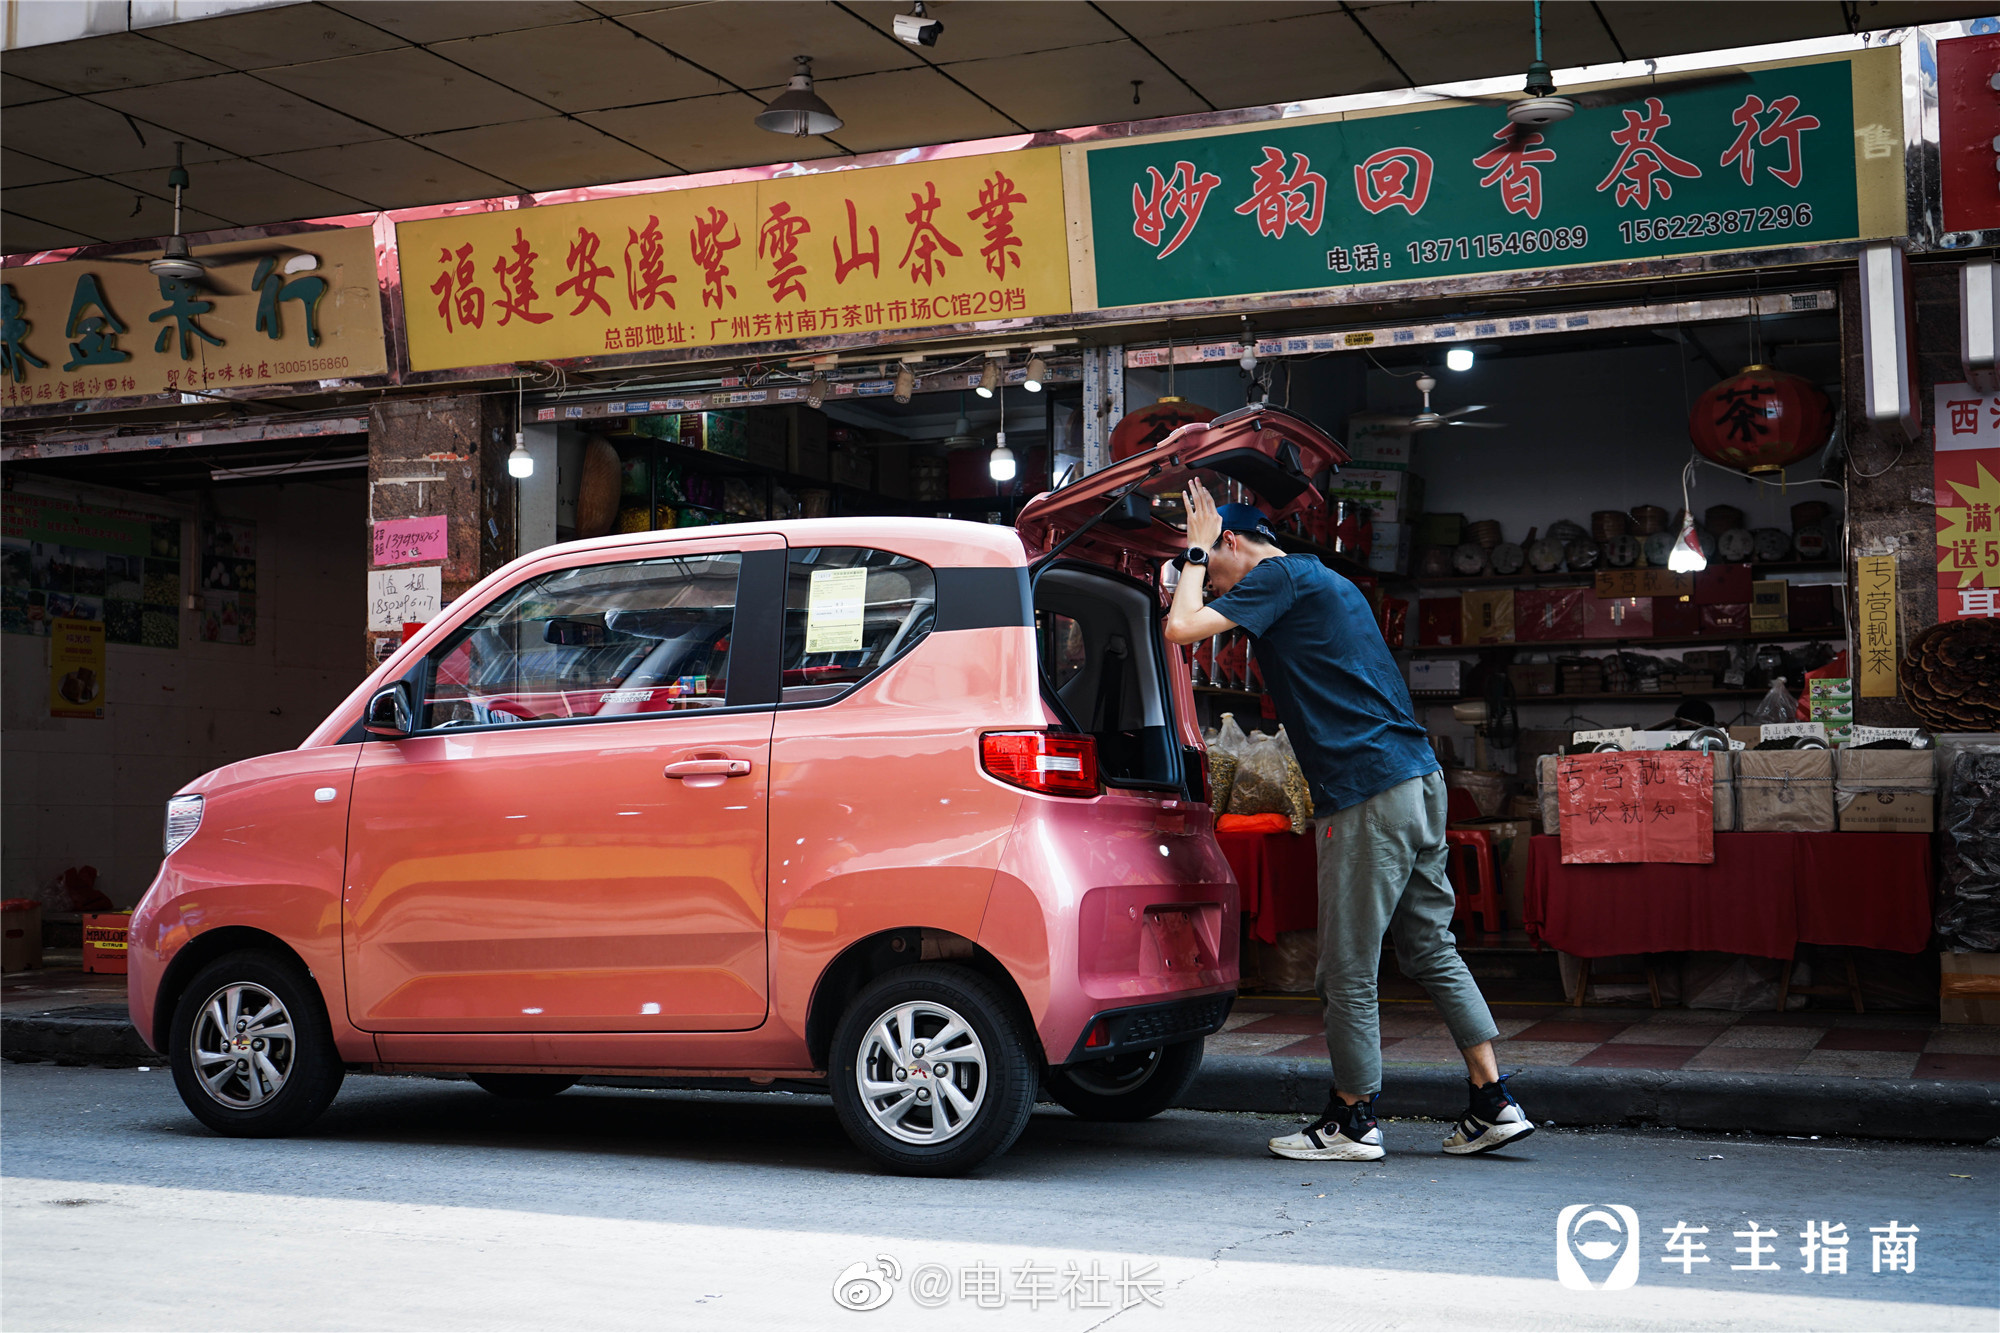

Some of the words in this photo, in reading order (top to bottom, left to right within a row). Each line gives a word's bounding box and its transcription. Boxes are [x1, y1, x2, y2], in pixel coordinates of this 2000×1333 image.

[1132, 94, 1820, 260] 妙韵回香茶行
[1618, 203, 1813, 244] 15622387296
[273, 356, 349, 376] 13005156860
[1716, 385, 1775, 441] 茶
[1565, 801, 1675, 825] 一饮就知
